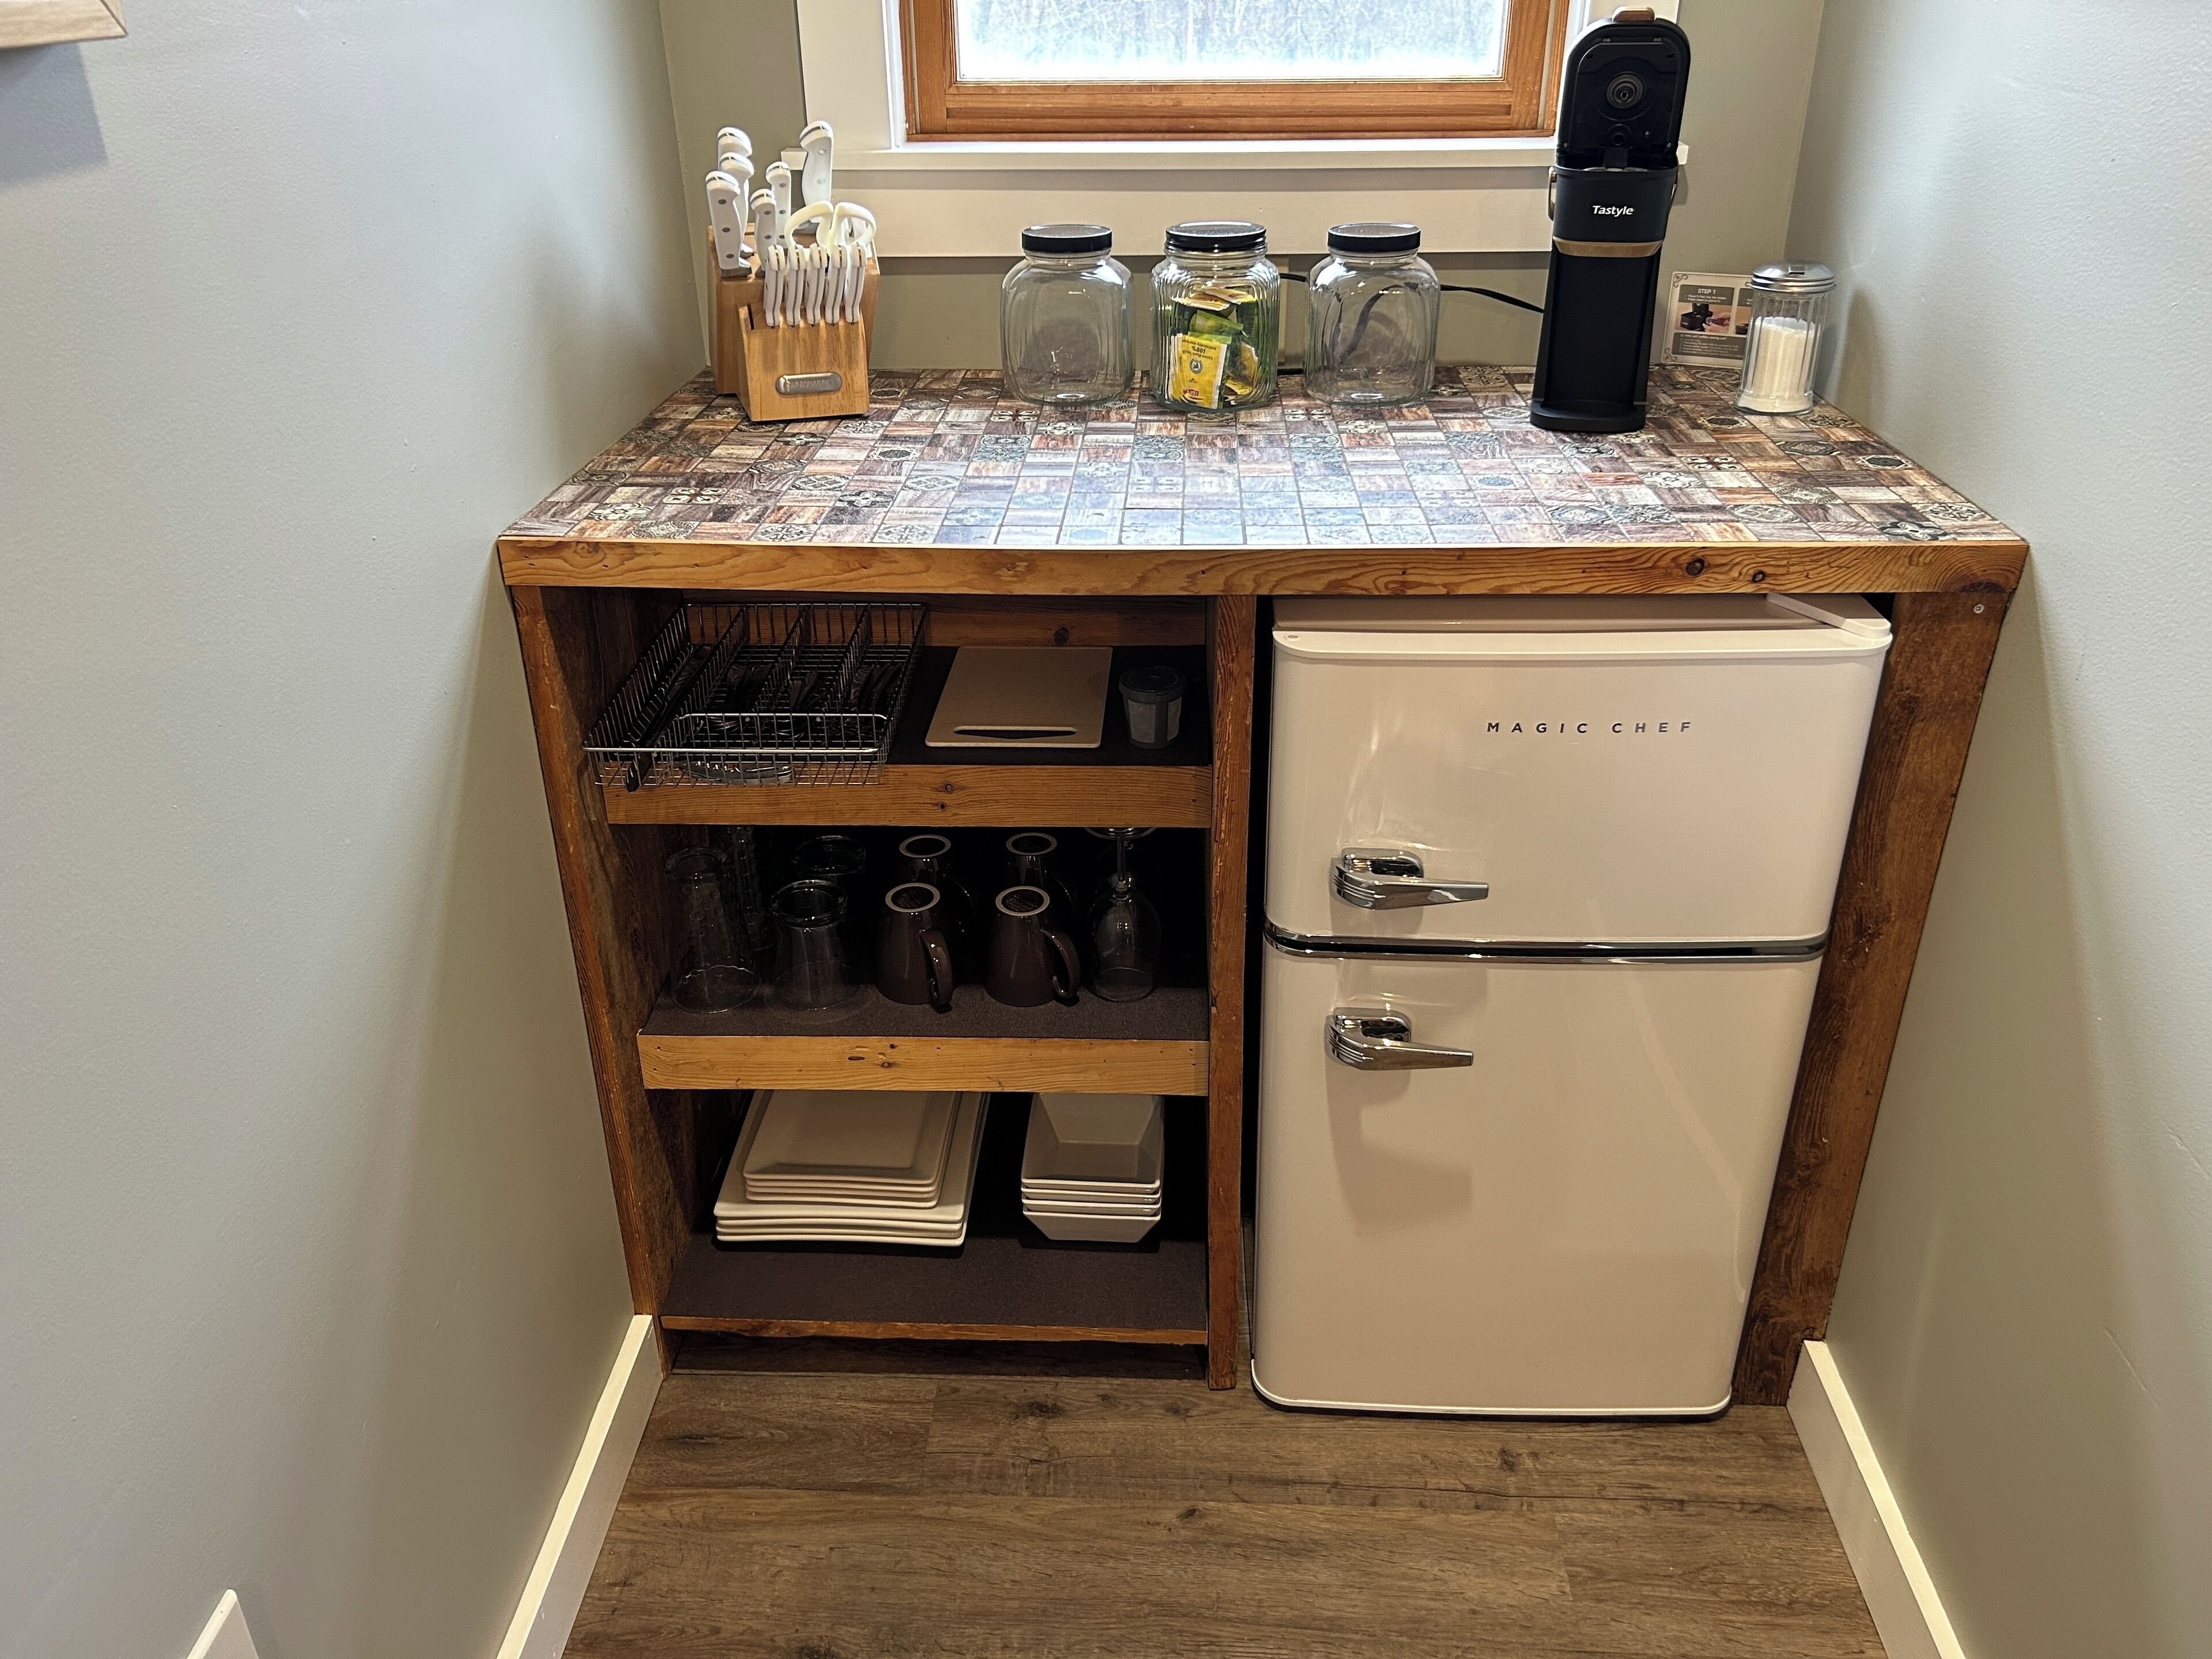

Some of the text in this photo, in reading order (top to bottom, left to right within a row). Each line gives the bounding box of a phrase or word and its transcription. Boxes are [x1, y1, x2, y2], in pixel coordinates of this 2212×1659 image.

[1592, 205, 1634, 217] Tastyle
[1191, 346, 1206, 354] 100%
[1487, 721, 1691, 734] MAGIC CHEF
